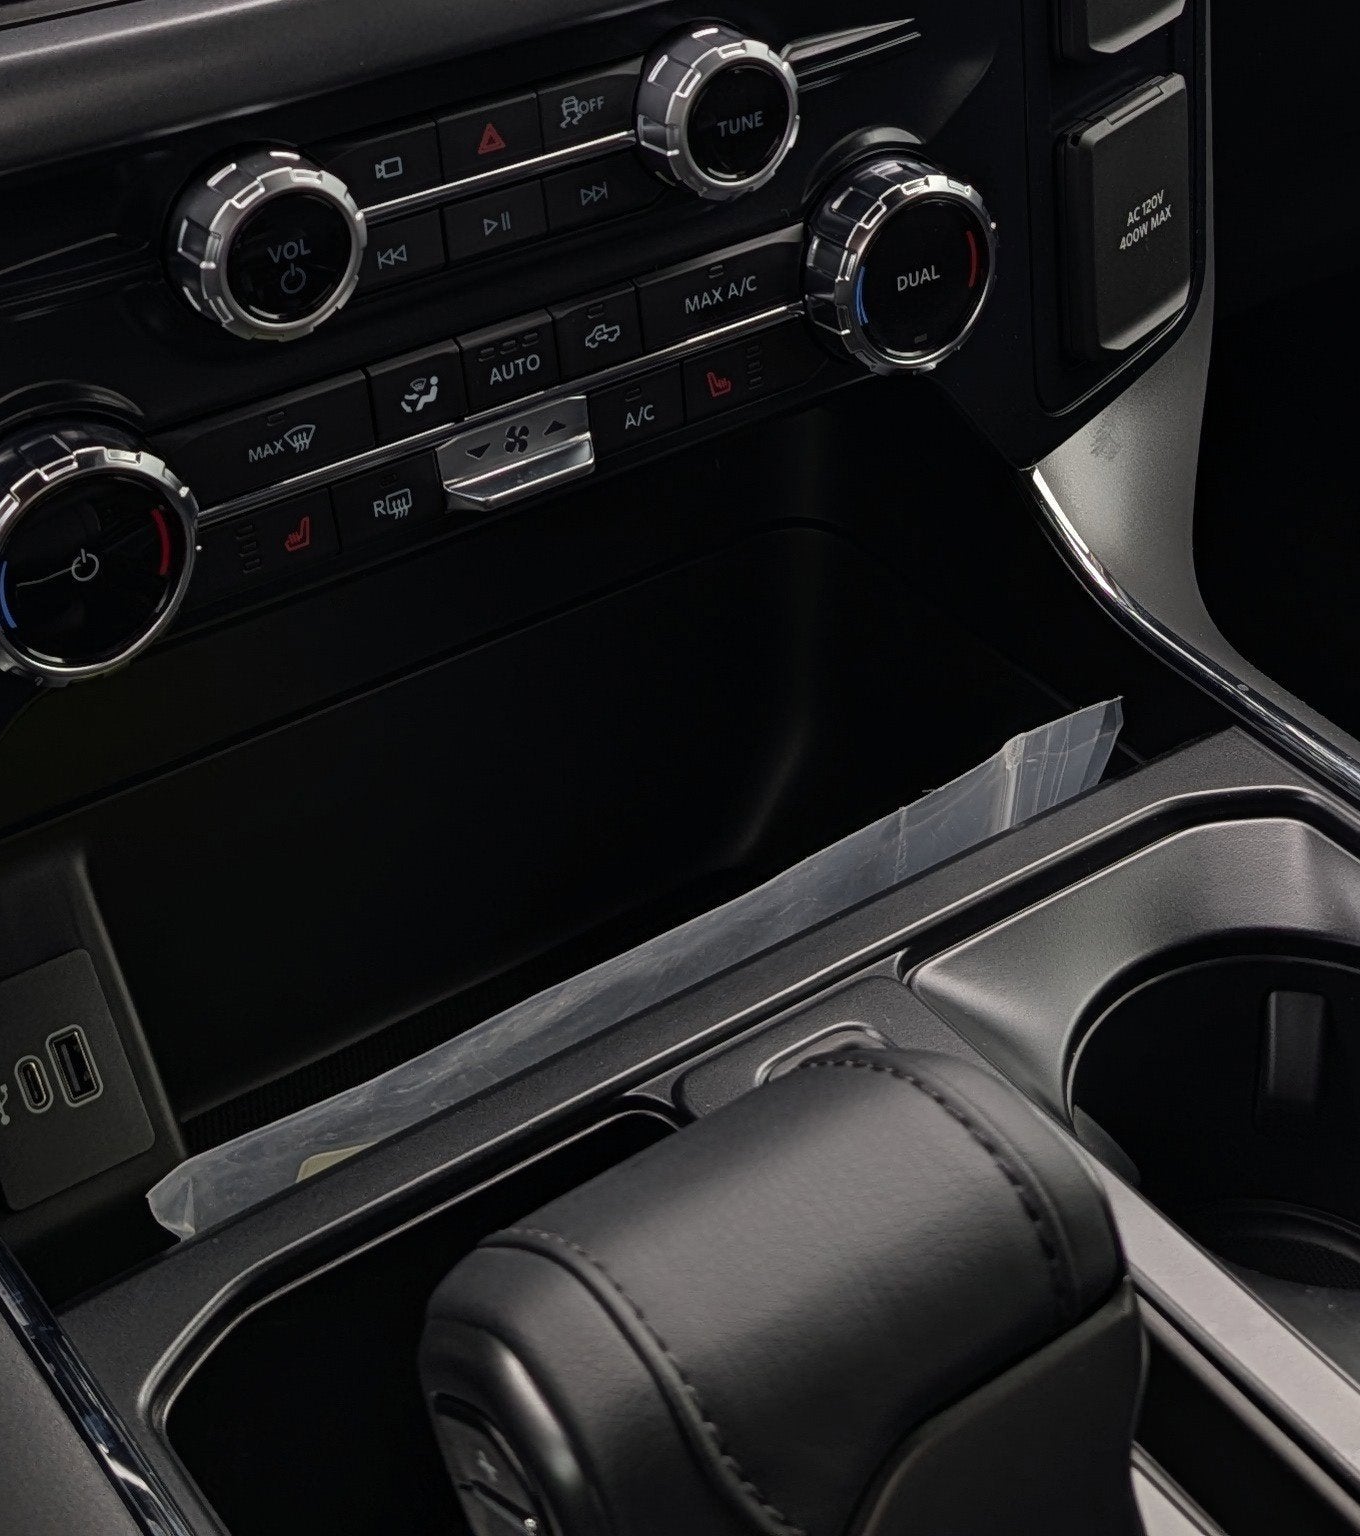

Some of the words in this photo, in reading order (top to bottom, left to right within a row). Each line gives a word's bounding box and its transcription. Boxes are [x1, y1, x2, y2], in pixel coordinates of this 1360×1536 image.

[579, 94, 605, 116] OFF
[716, 109, 765, 133] TUNE
[1126, 206, 1141, 228] AC
[1142, 189, 1165, 217] 120V
[1119, 223, 1148, 252] 400W
[1150, 203, 1172, 231] MAX
[267, 237, 311, 265] VOL
[896, 263, 941, 292] DUAL
[685, 284, 724, 314] MAX
[727, 275, 758, 304] A/C
[489, 353, 541, 386] AUTO
[624, 403, 656, 431] A/C
[248, 440, 285, 462] MAX
[373, 500, 386, 518] R
